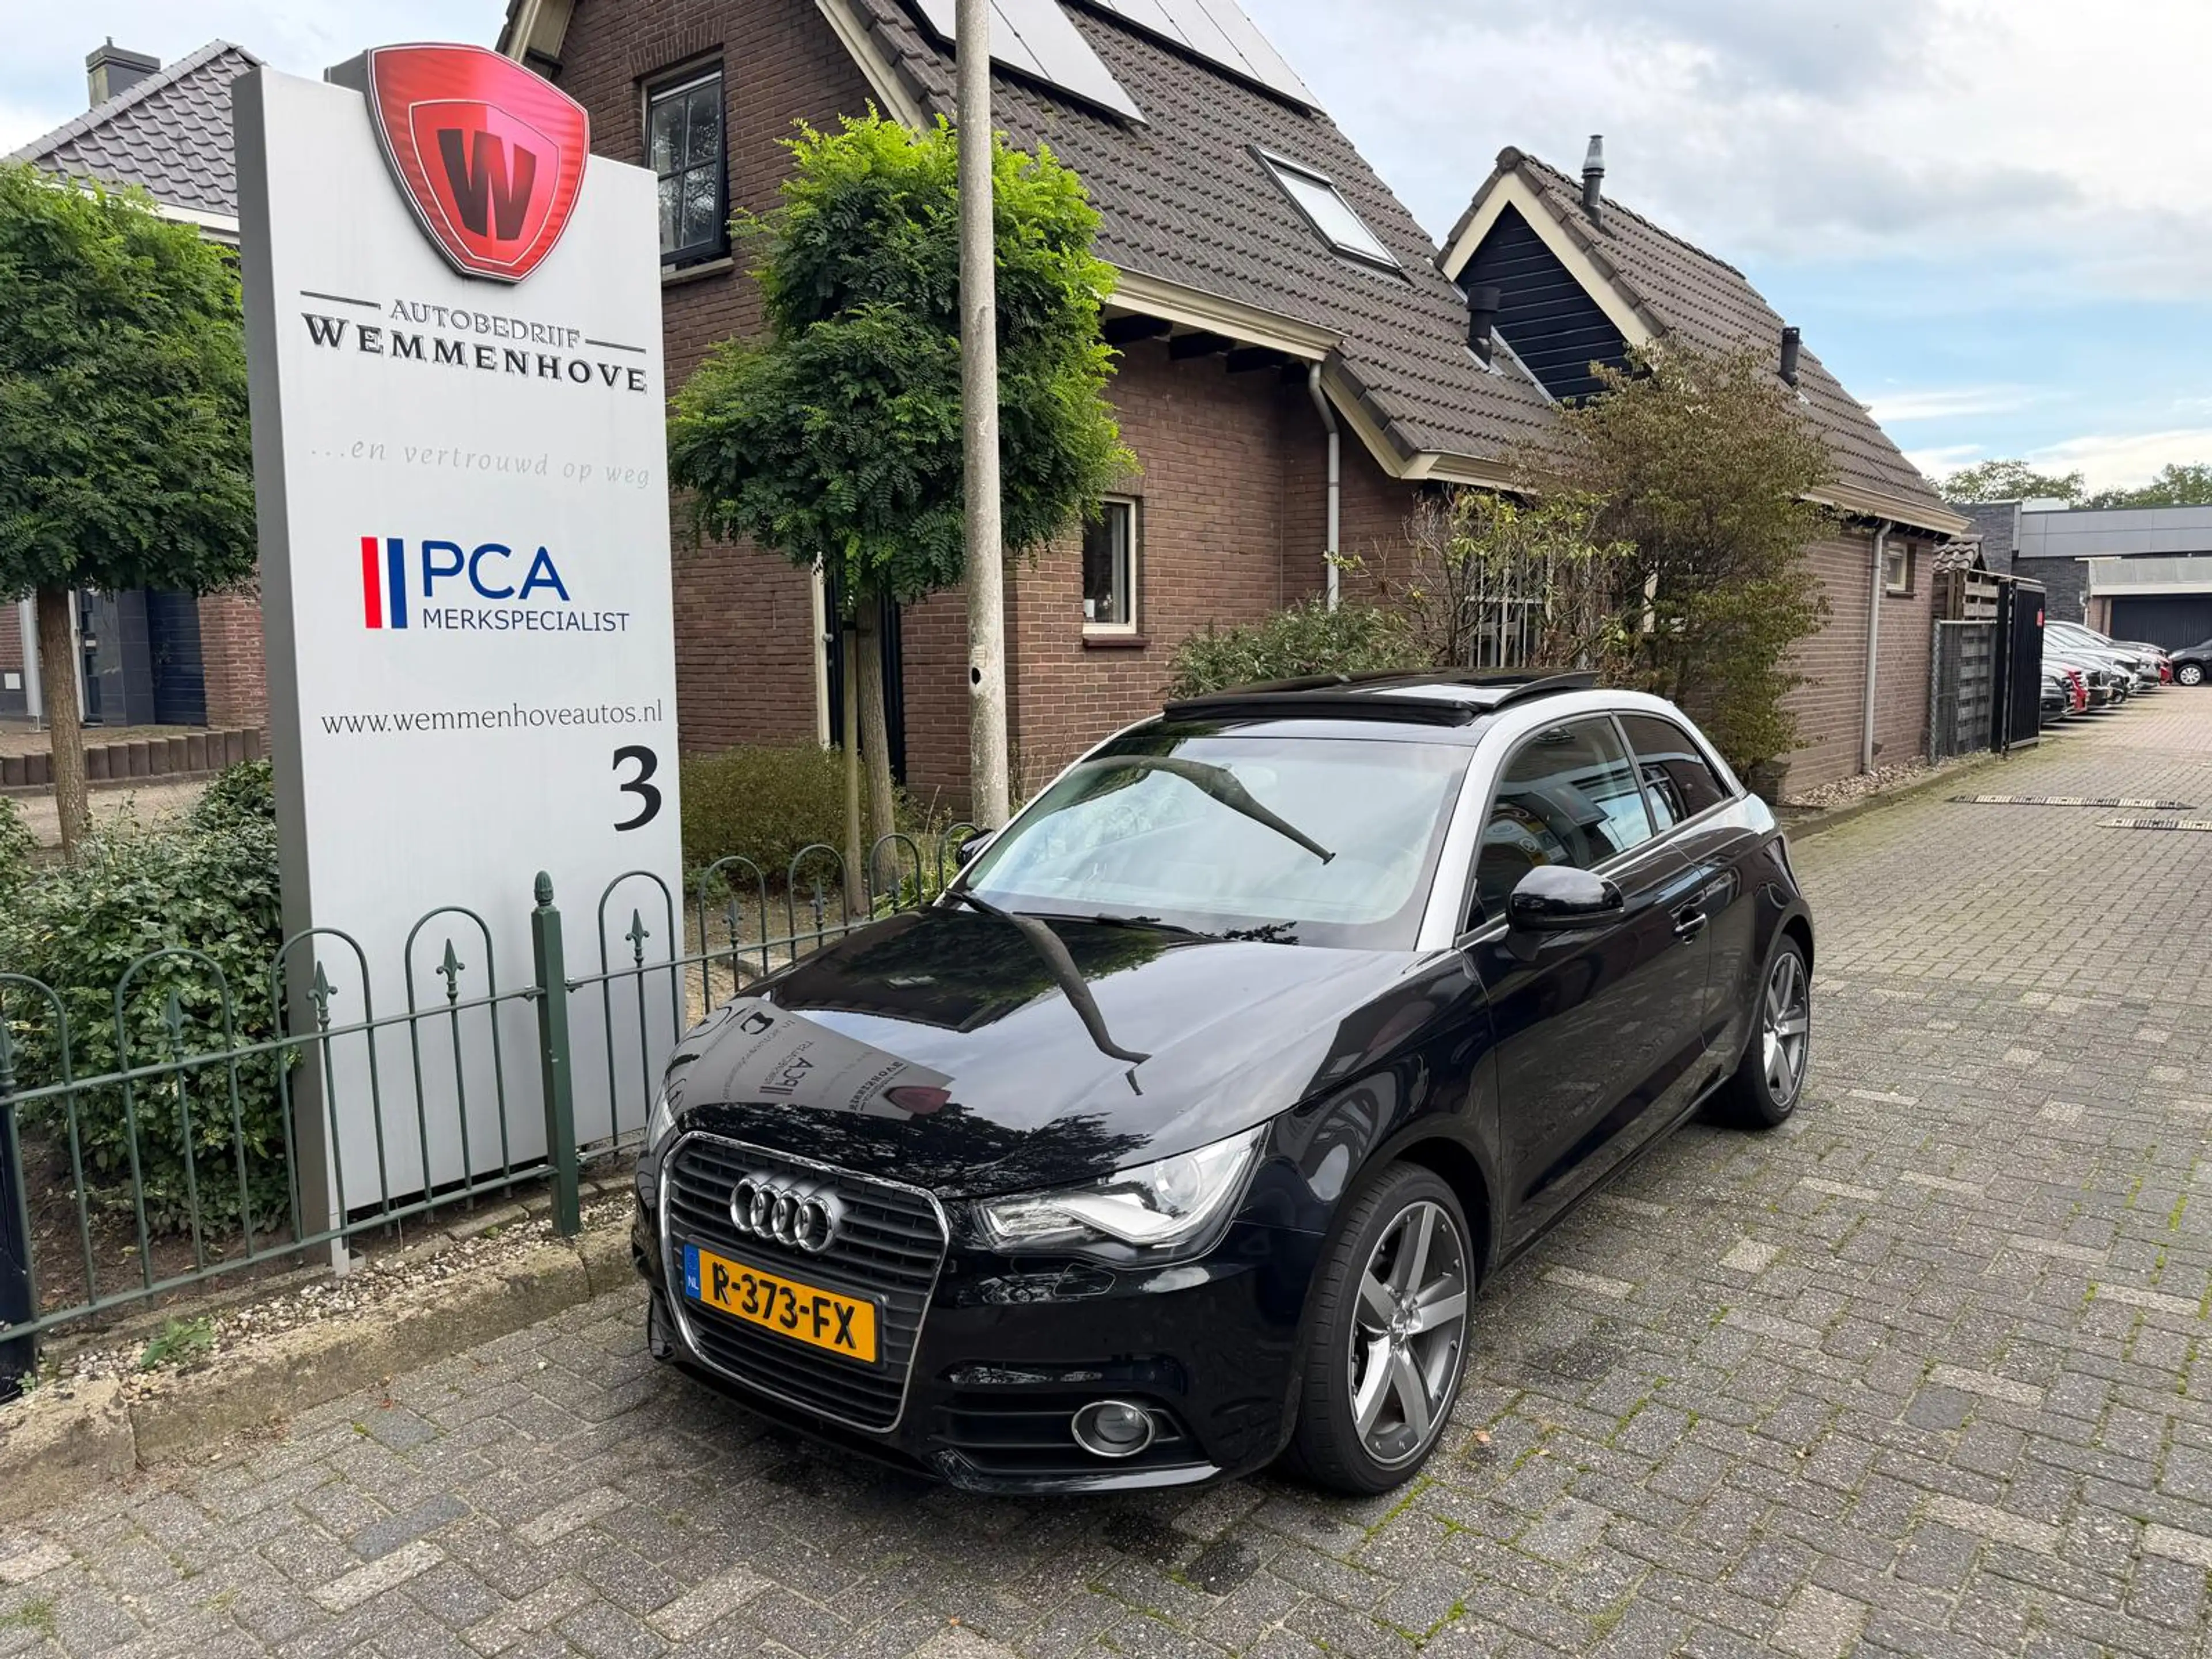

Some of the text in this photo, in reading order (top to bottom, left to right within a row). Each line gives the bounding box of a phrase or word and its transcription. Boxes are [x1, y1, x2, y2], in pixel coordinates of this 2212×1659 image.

[436, 128, 537, 241] W
[300, 312, 648, 393] WEMMENHOVE
[390, 298, 580, 349] AUTOBEDRIJF
[404, 446, 548, 476] vertrouwd
[563, 463, 593, 484] op
[605, 466, 649, 489] weg
[421, 539, 570, 602] PCA
[422, 608, 630, 632] MERKSPECIALIST
[321, 699, 663, 734] www.wemmenhoveautos.nl
[612, 744, 662, 832] 3
[711, 1260, 857, 1350] R-373-FX
